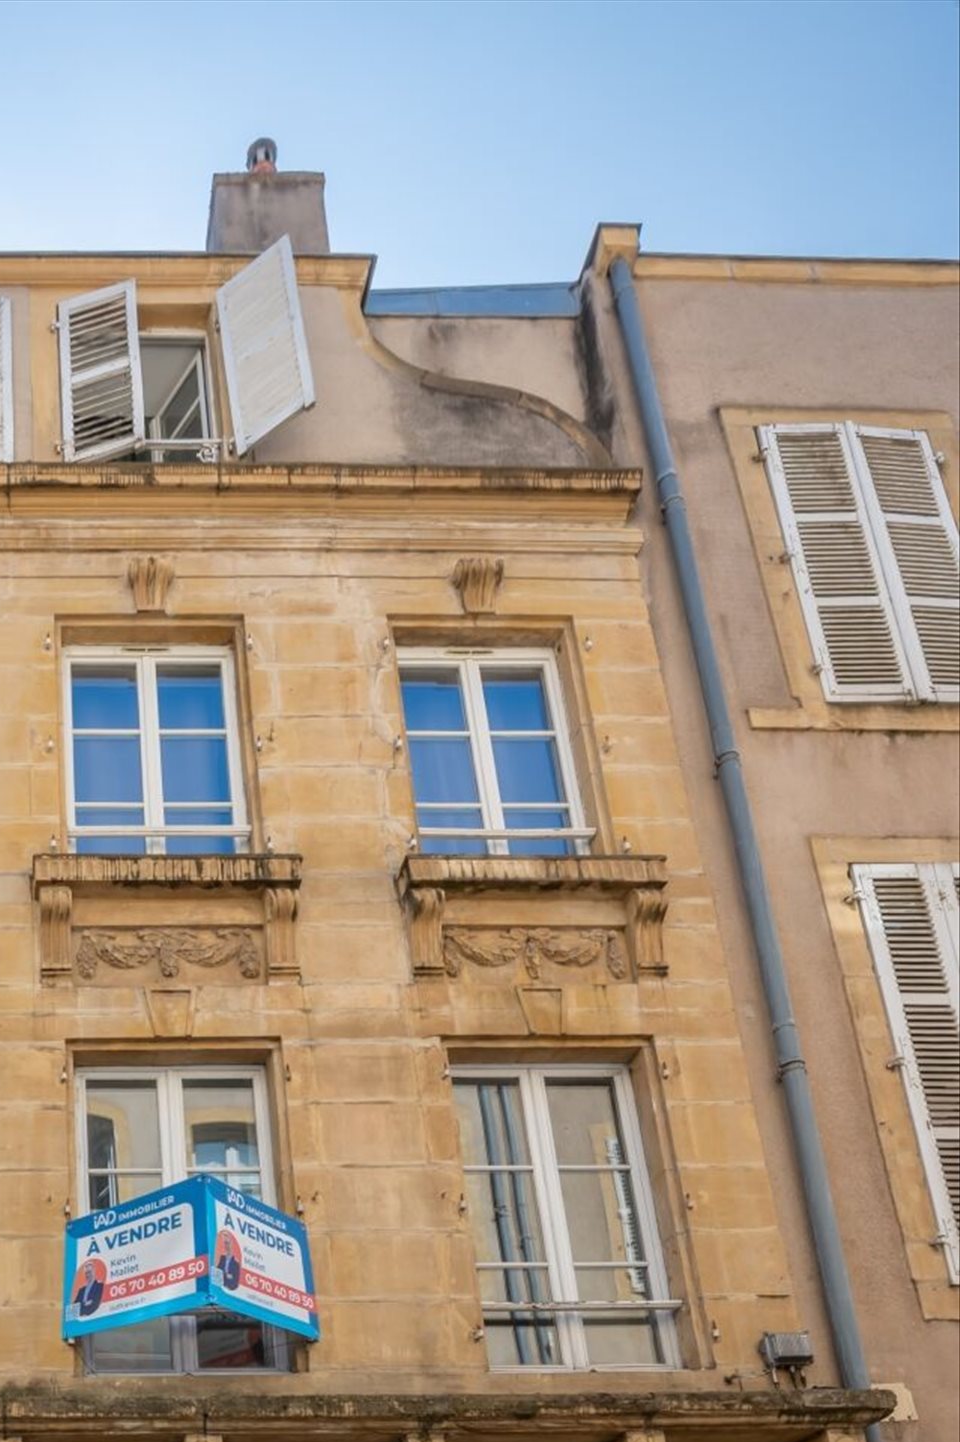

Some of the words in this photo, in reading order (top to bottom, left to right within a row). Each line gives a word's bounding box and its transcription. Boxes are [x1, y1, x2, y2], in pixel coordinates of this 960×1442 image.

[93, 1210, 116, 1230] iAD
[118, 1195, 175, 1221] IMMOBILIER
[87, 1237, 100, 1256] À
[105, 1212, 182, 1250] VENDRE
[237, 1218, 295, 1257] VENDRE
[110, 1283, 127, 1298] 06
[129, 1278, 145, 1292] 70
[148, 1272, 166, 1287] 40
[168, 1266, 185, 1281] 89
[188, 1260, 205, 1275] 50
[259, 1278, 273, 1293] 70
[274, 1285, 288, 1299] 40
